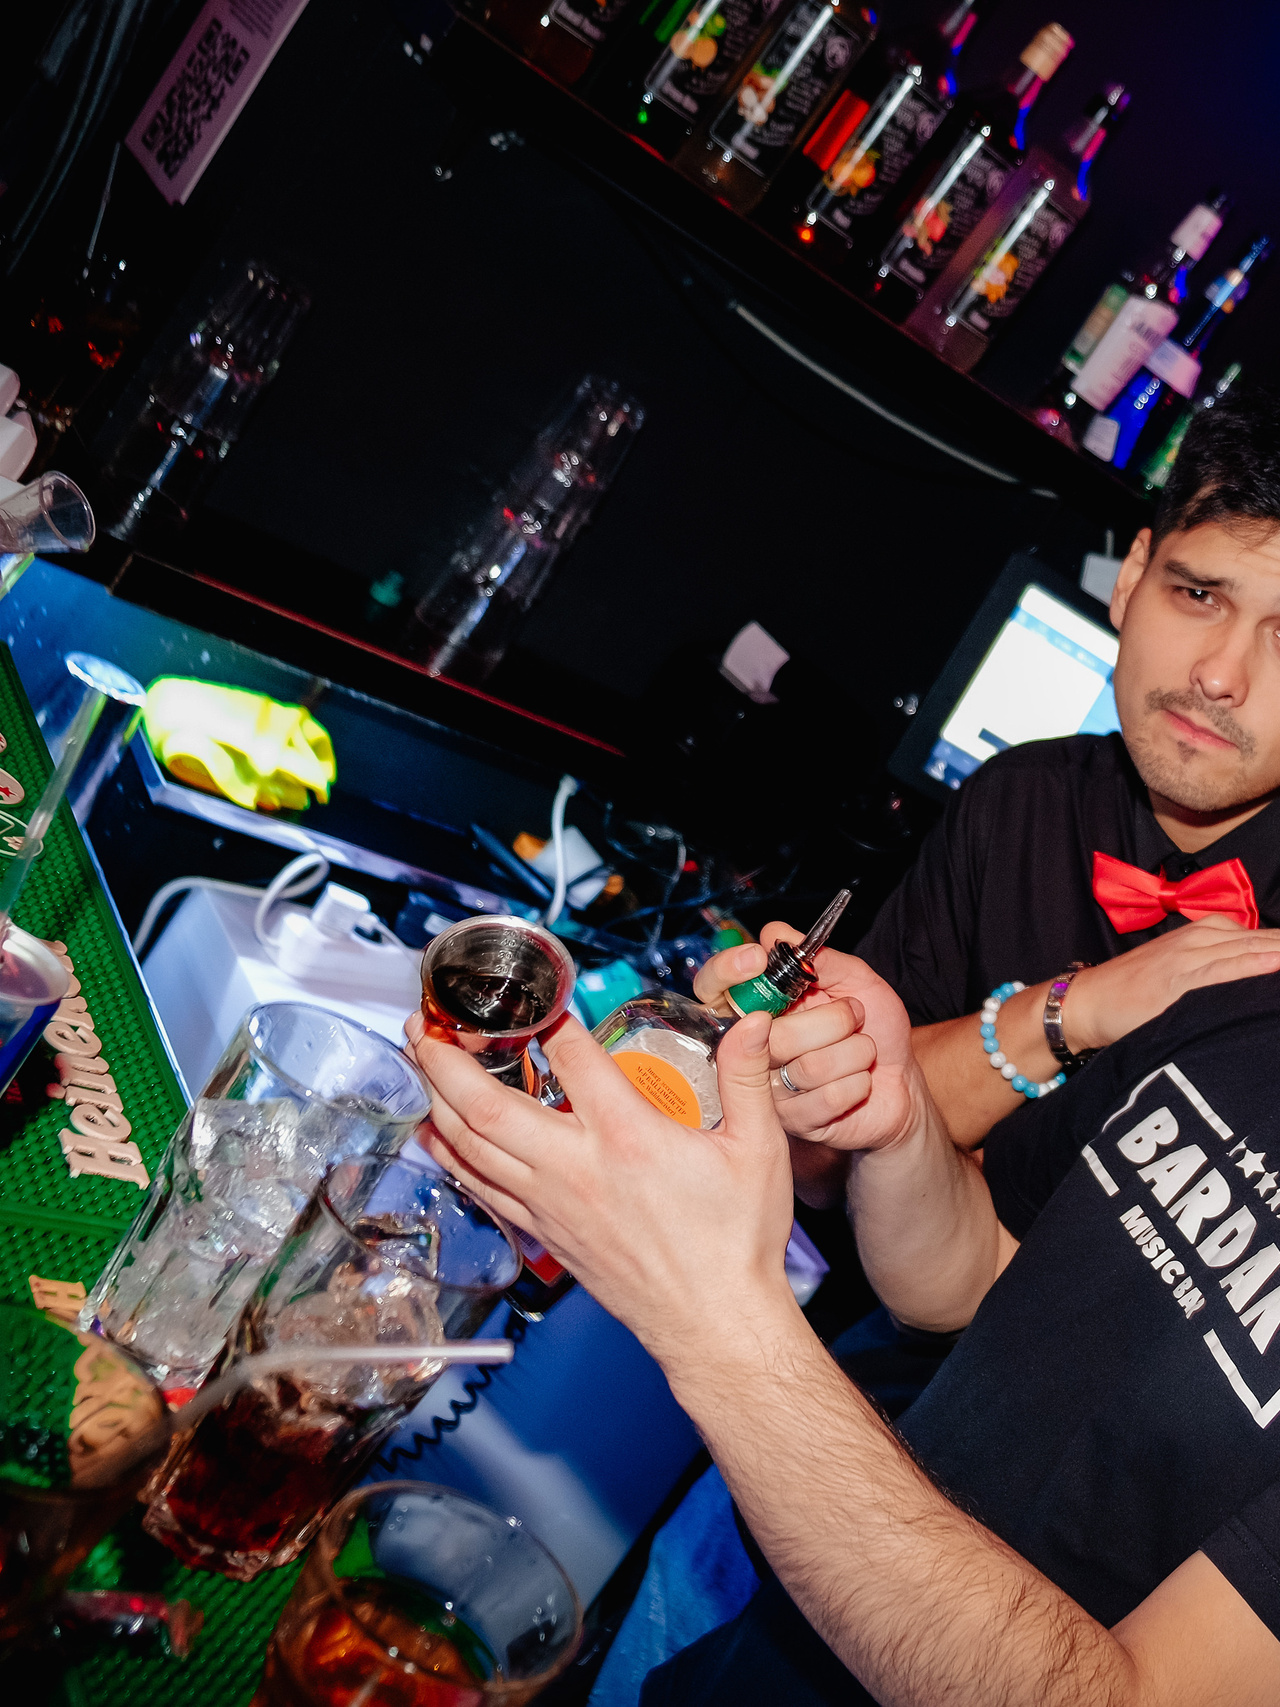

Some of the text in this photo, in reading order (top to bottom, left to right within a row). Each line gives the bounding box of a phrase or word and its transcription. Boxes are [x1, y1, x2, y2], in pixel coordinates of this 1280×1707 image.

[45, 939, 149, 1190] Heine
[1119, 1204, 1206, 1319] MUSIC BAR
